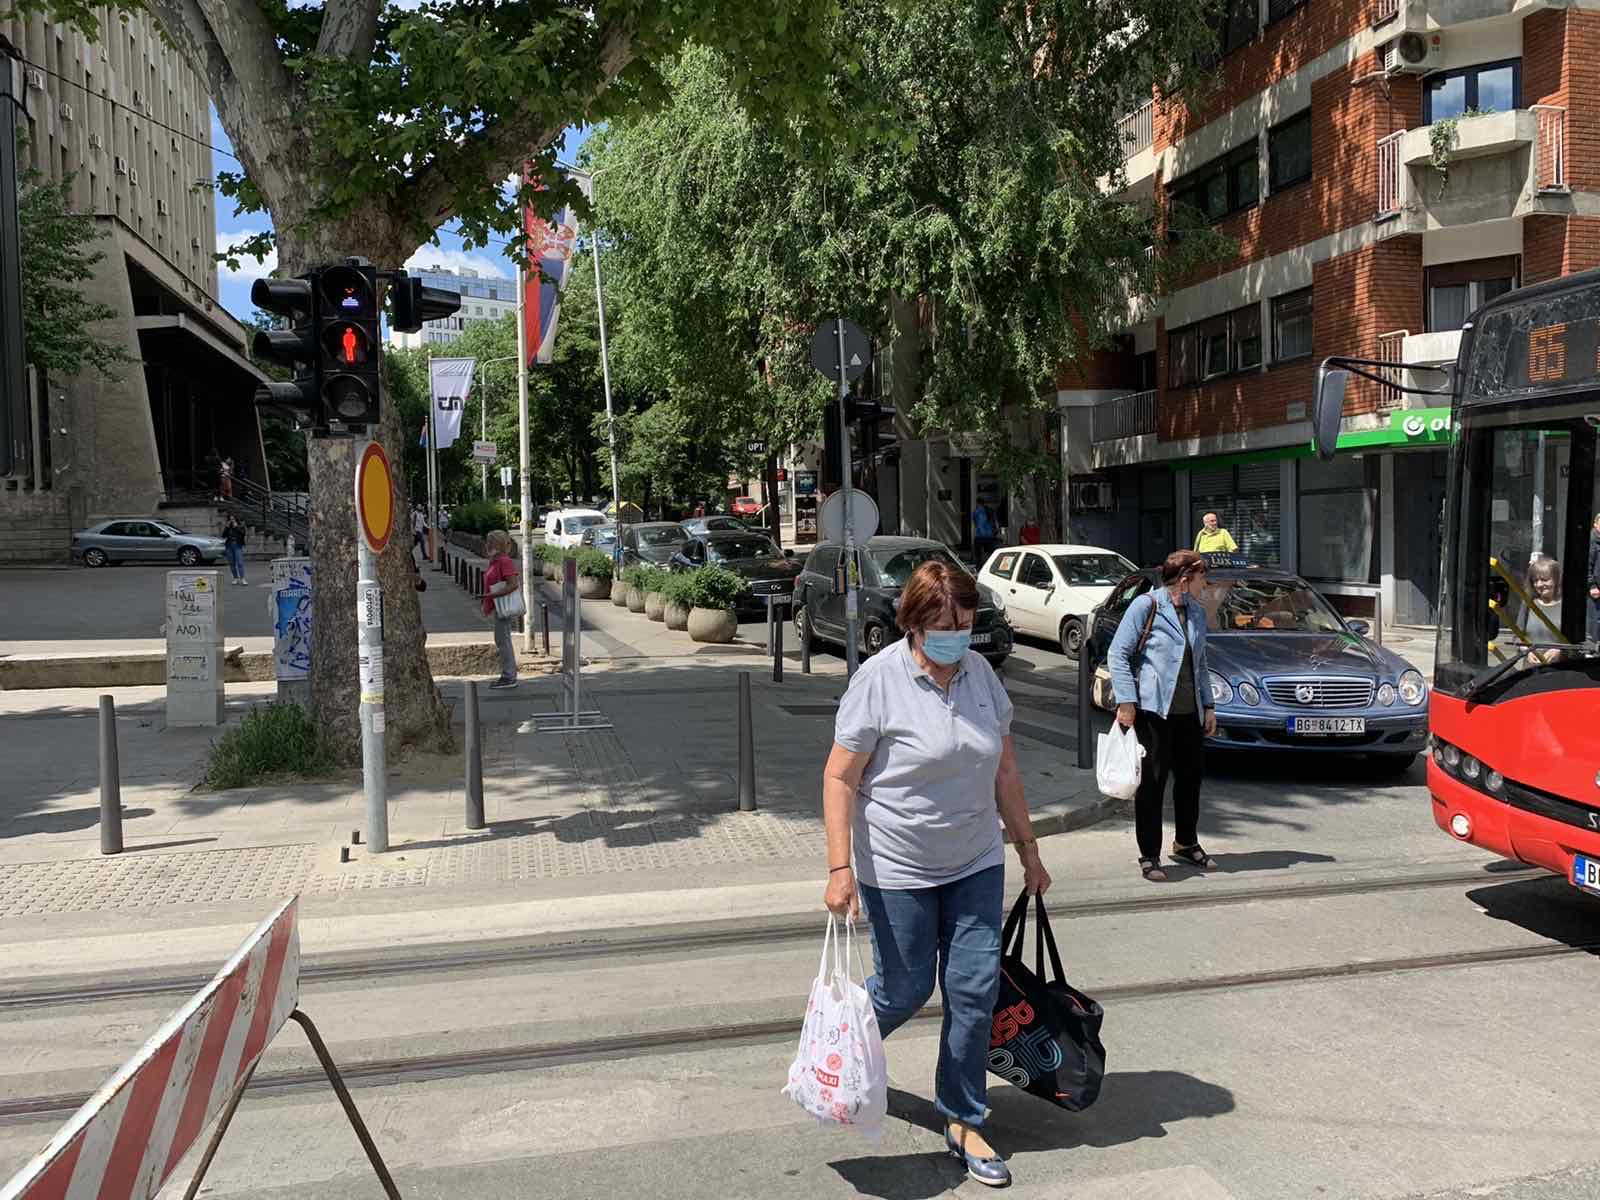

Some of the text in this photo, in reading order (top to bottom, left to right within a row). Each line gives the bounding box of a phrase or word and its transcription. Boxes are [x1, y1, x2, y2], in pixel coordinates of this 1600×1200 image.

[1529, 323, 1568, 384] 65
[1296, 719, 1311, 731] BG
[818, 1071, 838, 1086] MAXI
